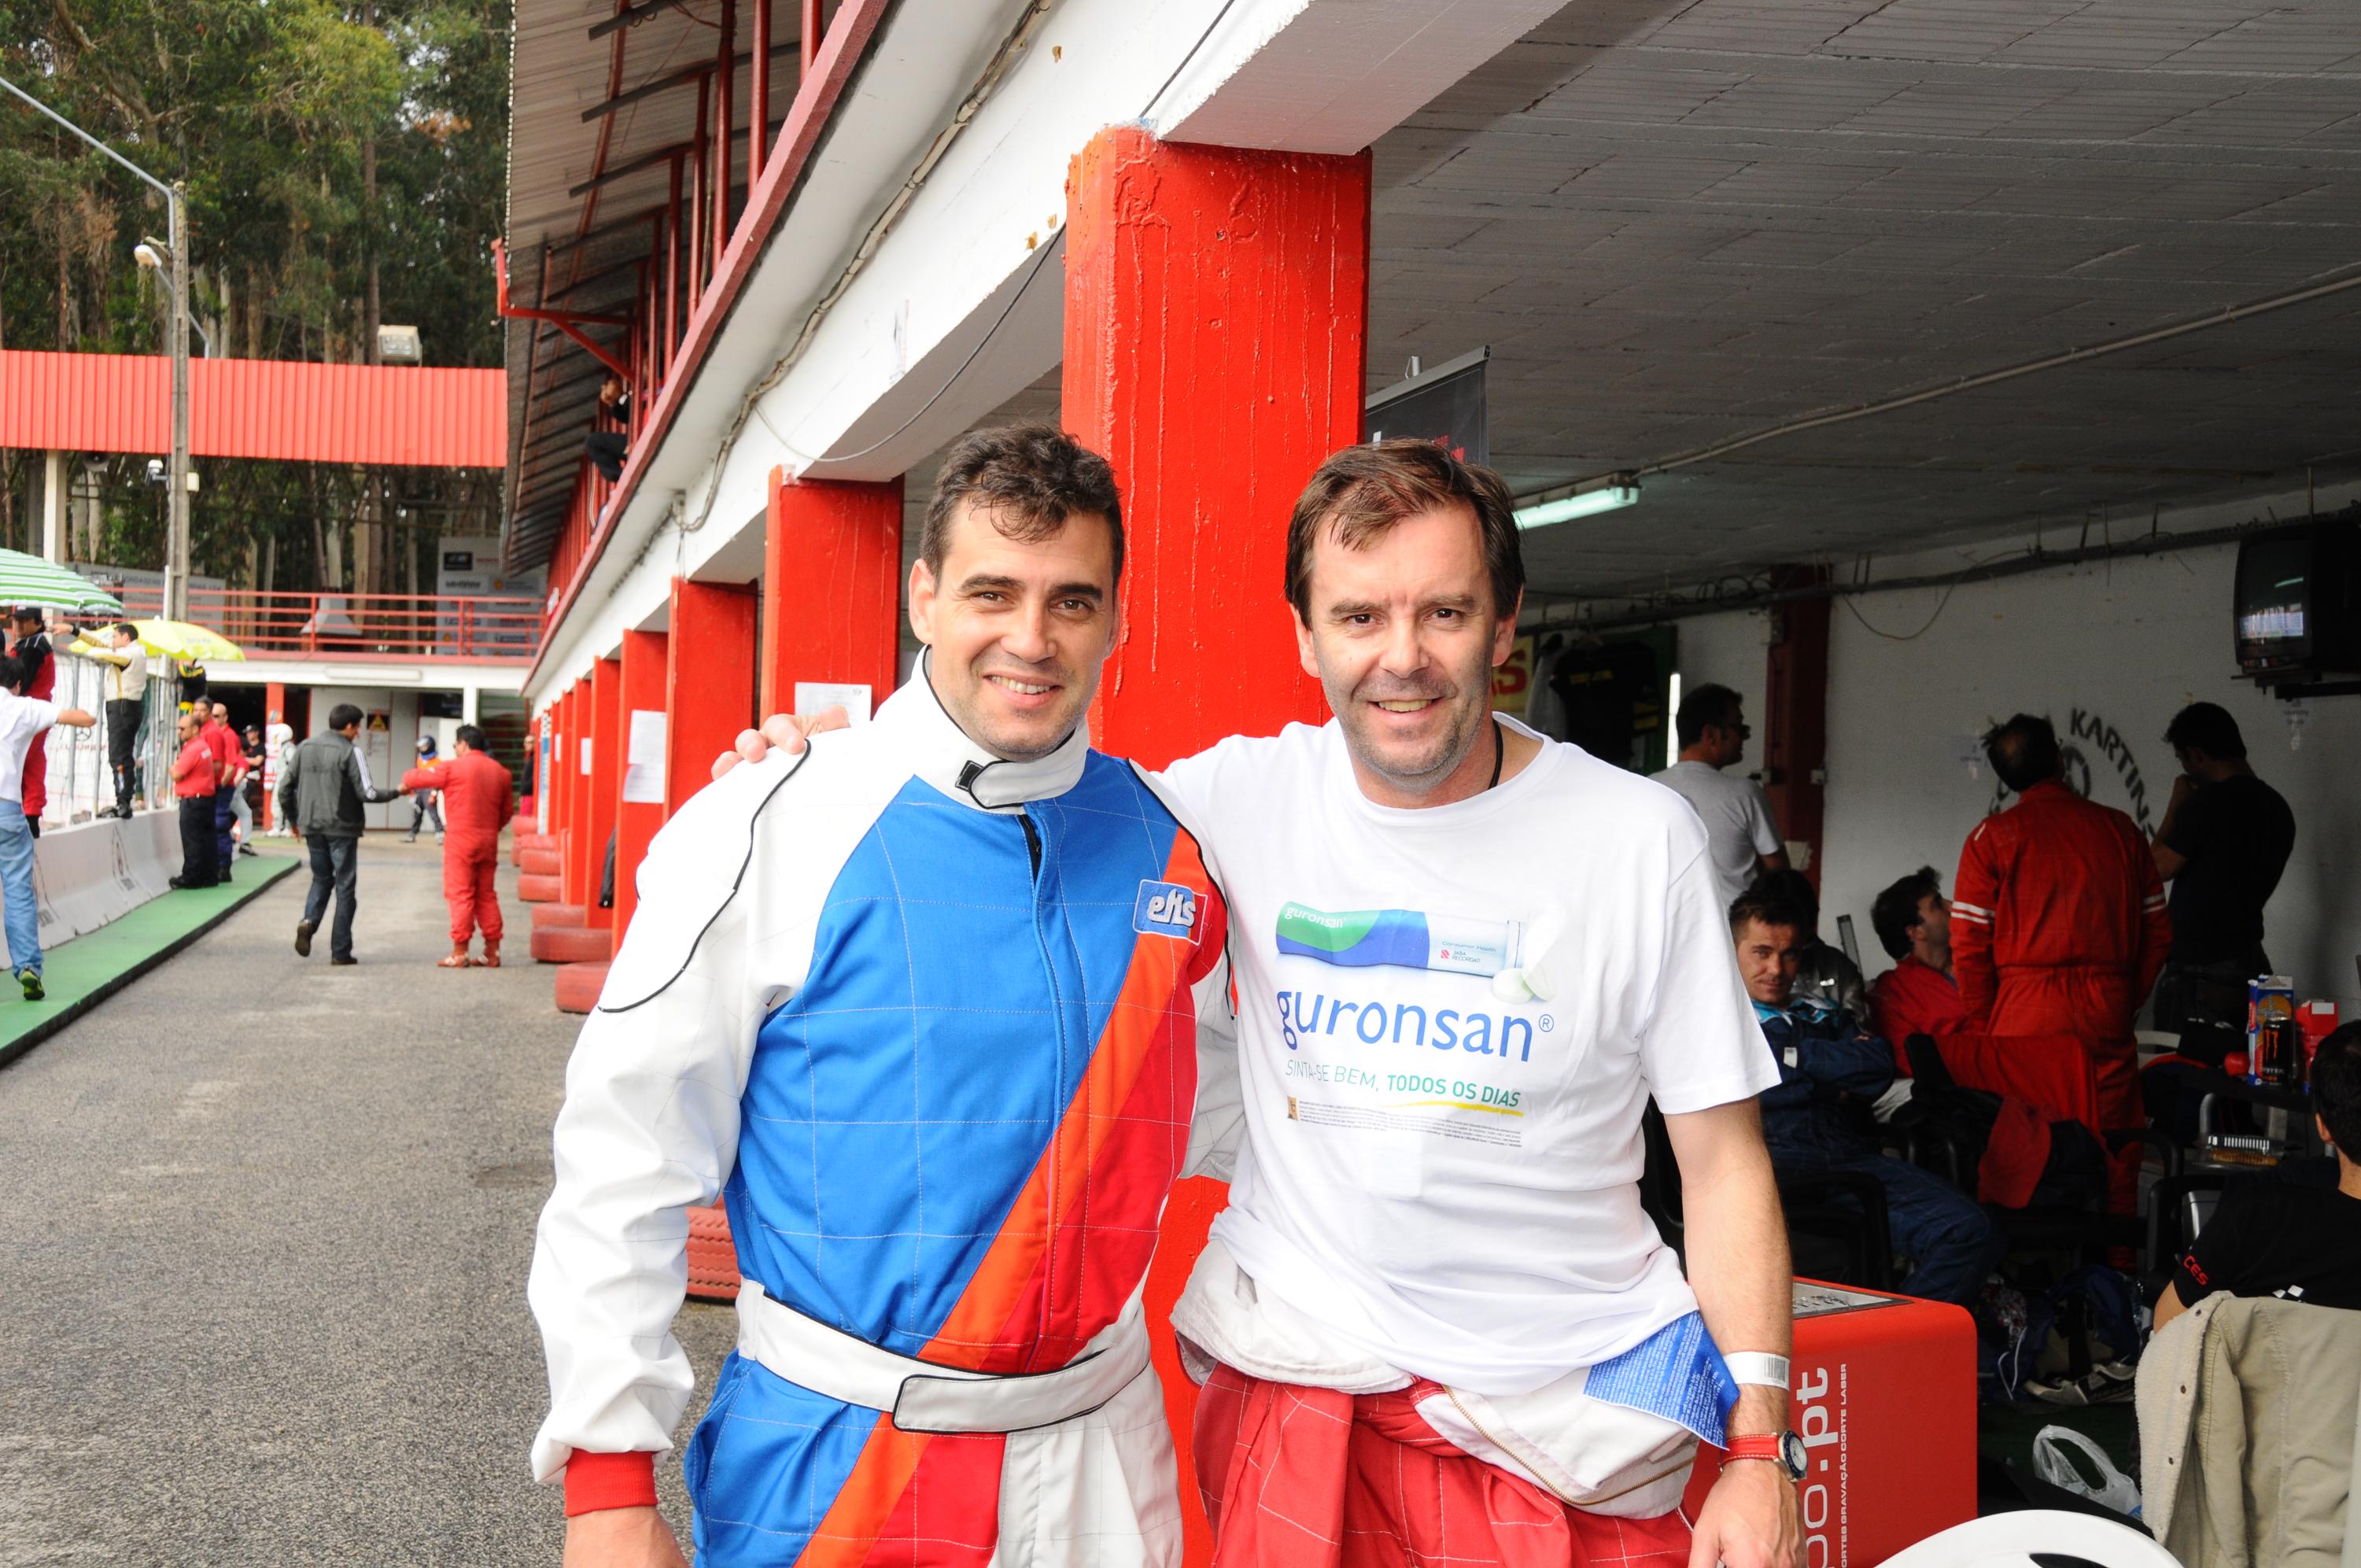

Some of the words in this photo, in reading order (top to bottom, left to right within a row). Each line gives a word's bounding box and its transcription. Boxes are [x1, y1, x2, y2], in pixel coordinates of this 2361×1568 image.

[1286, 1059, 1330, 1083] SINTA-SE
[1334, 1065, 1379, 1092] BEM,
[1387, 1074, 1447, 1095] TODOS
[1452, 1081, 1477, 1100] OS
[1481, 1086, 1522, 1108] DIAS
[1839, 1453, 1848, 1524] GRAVAÇÃO
